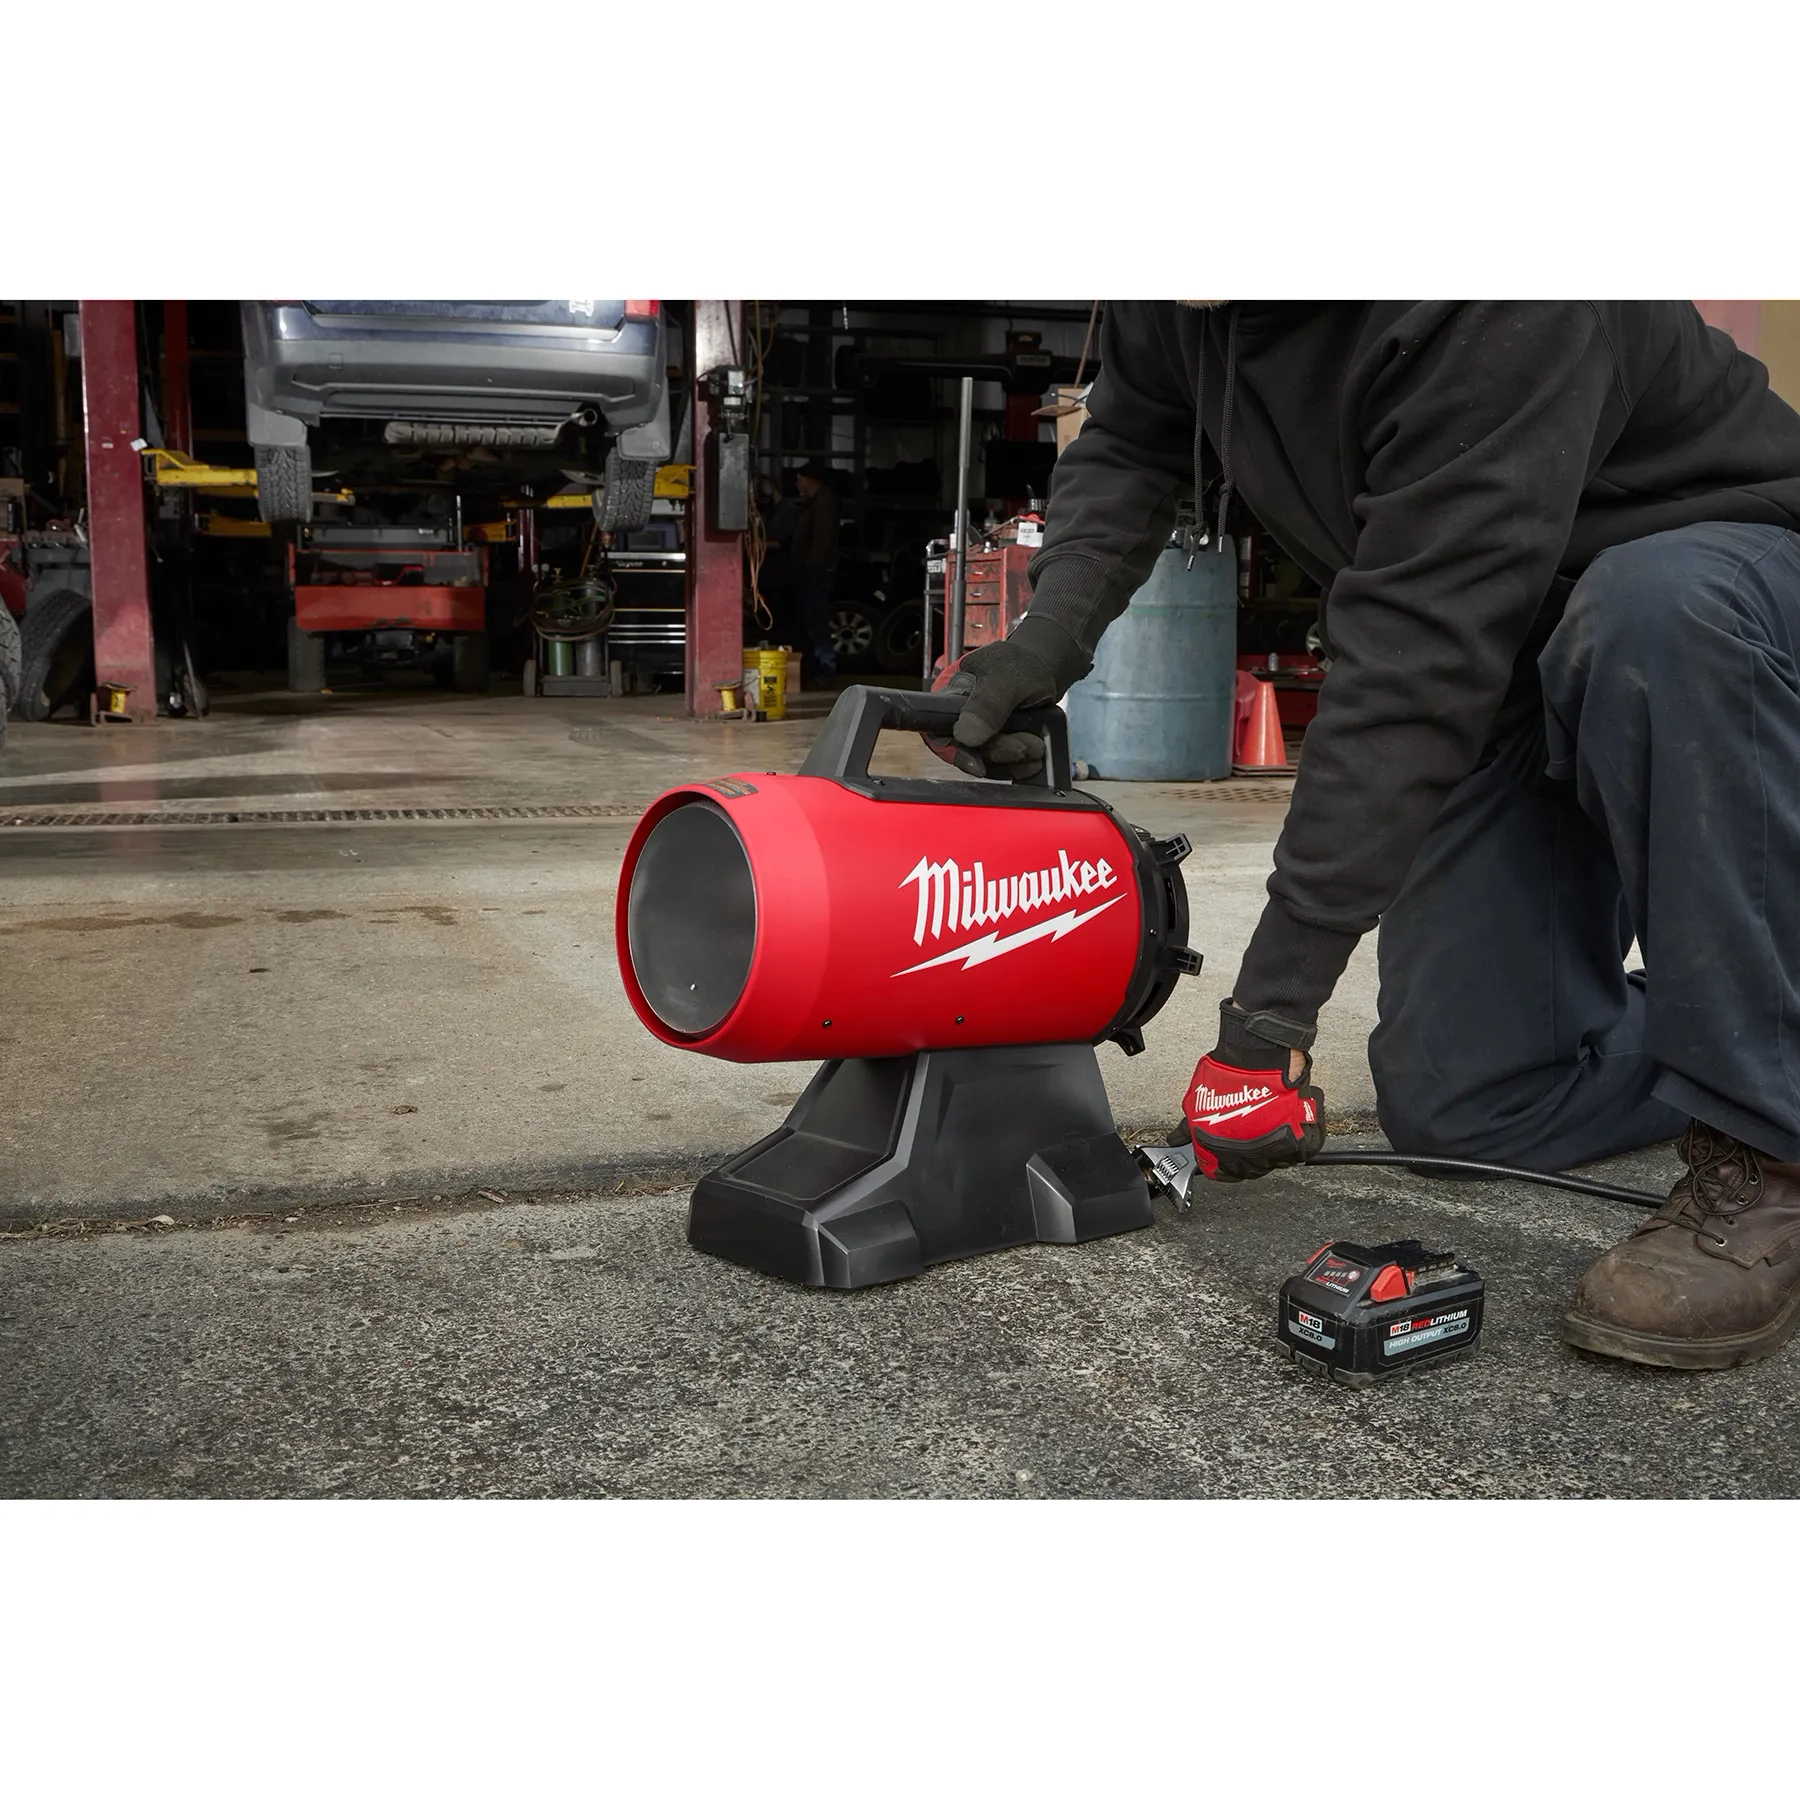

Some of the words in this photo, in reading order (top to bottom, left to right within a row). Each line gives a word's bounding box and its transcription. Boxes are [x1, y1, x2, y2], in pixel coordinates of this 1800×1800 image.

[898, 849, 1118, 947] Milwaukee
[1195, 1084, 1273, 1113] Milwaukee
[1299, 1326, 1322, 1342] XC8.0
[1300, 1313, 1321, 1329] M18
[1391, 1323, 1410, 1335] M18
[1411, 1309, 1468, 1331] REDLITHIUM
[1389, 1337, 1410, 1349] HIGH
[1410, 1328, 1442, 1342] OUTPUT
[1443, 1322, 1467, 1334] XC8.0
